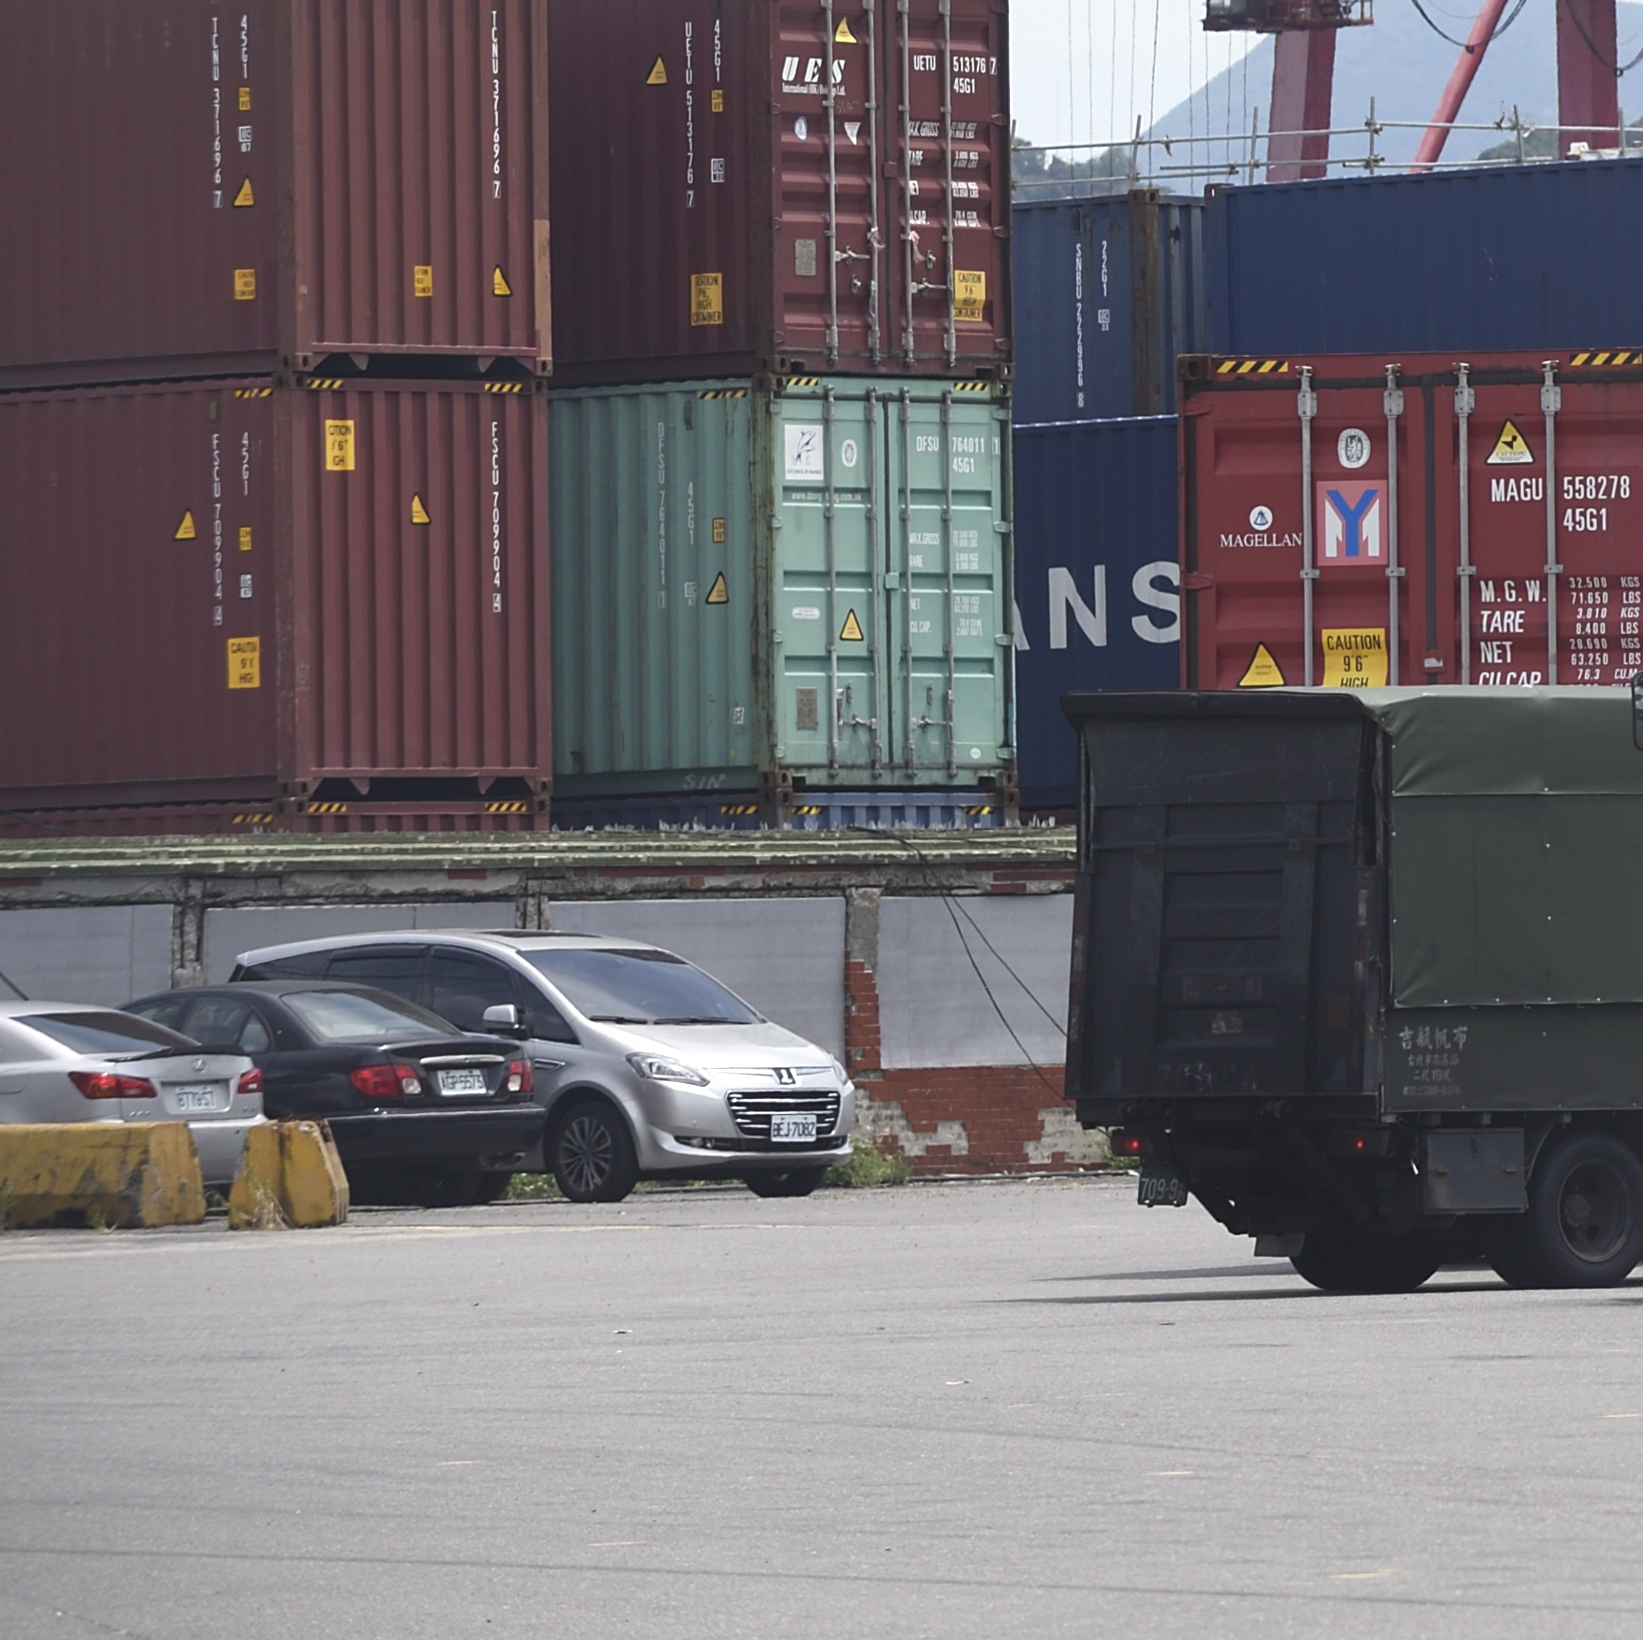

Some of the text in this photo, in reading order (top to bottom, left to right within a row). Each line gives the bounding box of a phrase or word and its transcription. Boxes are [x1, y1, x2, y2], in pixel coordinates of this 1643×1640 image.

[212, 17, 220, 81] TCNU
[240, 14, 248, 79] 45G1
[491, 10, 500, 74] TCNU
[685, 21, 693, 85] UETU
[913, 55, 997, 75] UETU 513176 7
[953, 77, 976, 94] 45G1
[213, 88, 222, 184] 371696
[493, 180, 501, 198] 7
[686, 191, 694, 208] 7
[1075, 243, 1083, 299] SNBU
[1076, 302, 1084, 387] 222996
[657, 422, 665, 484] DFSU
[916, 435, 939, 452] DFSU
[952, 436, 985, 454] 764011
[212, 433, 221, 498] FSCU
[241, 432, 249, 496] 45G1
[952, 457, 975, 474] 45G1
[1491, 477, 1543, 502] MAGU
[1563, 475, 1630, 500] 558278
[687, 482, 695, 545] 45G1
[1563, 508, 1608, 532] 45G1
[214, 503, 222, 600] 709904
[492, 491, 500, 588] 709904
[1219, 532, 1303, 548] MAGELLAN
[1480, 576, 1641, 603] M.G.W. 32.500 KGS
[1571, 591, 1641, 604] 71.650 LBS
[1014, 561, 1181, 651] NS
[1480, 607, 1641, 634] TARE 3.810 KGS
[1576, 622, 1640, 635] 8.400 LBS
[1326, 635, 1382, 650] CAUTION
[1480, 641, 1513, 663] NET
[1620, 637, 1641, 649] KGS
[1571, 653, 1642, 665] 63.250 LBS
[1577, 669, 1601, 680] 76.3
[772, 1121, 816, 1138] BEJ-7082
